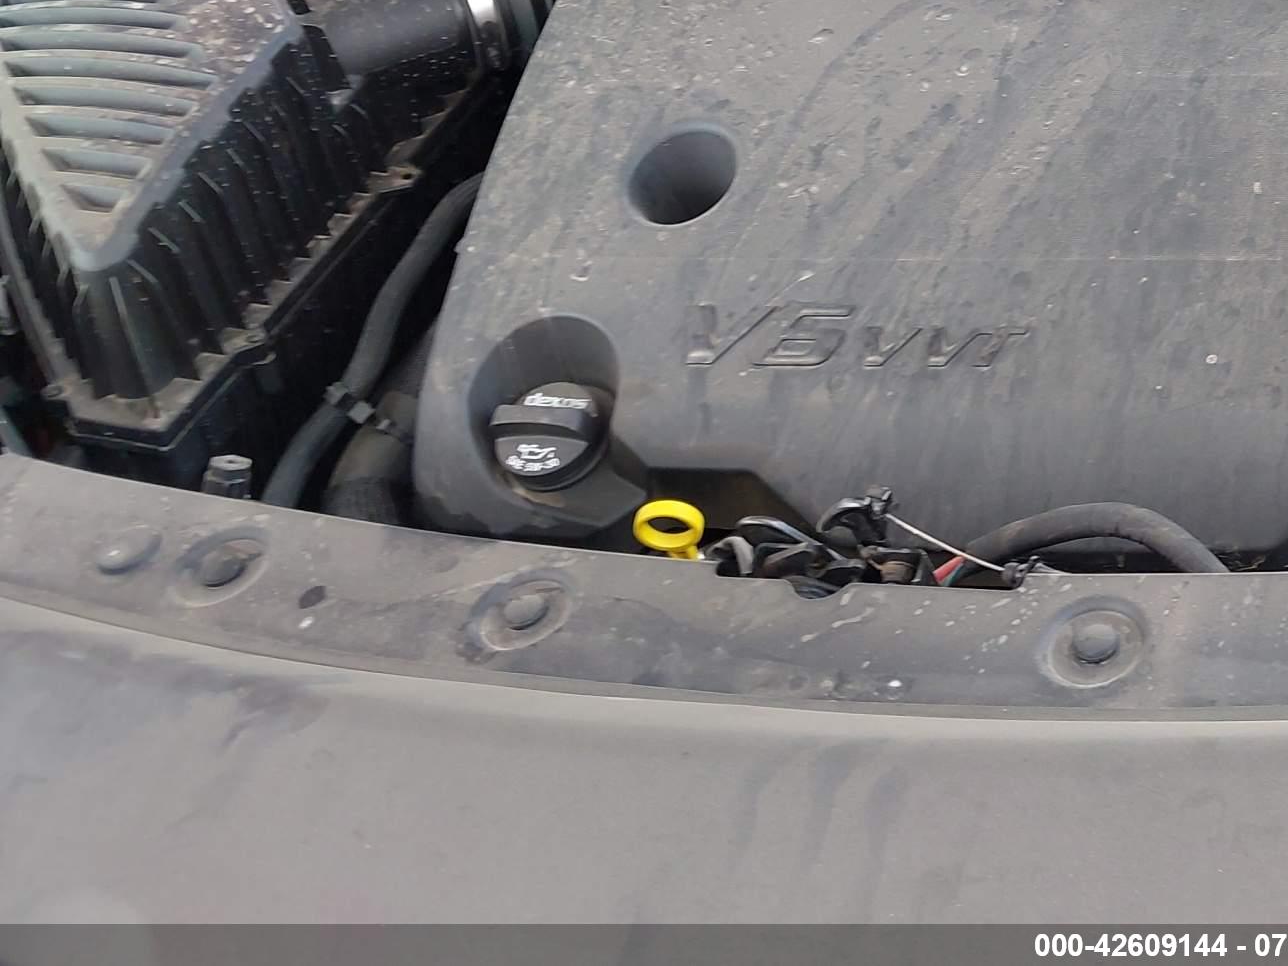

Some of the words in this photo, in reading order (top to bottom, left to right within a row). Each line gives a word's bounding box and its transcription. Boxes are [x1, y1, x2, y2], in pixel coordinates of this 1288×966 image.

[686, 304, 858, 367] V6
[861, 322, 1039, 368] VVT
[523, 392, 592, 410] dexos
